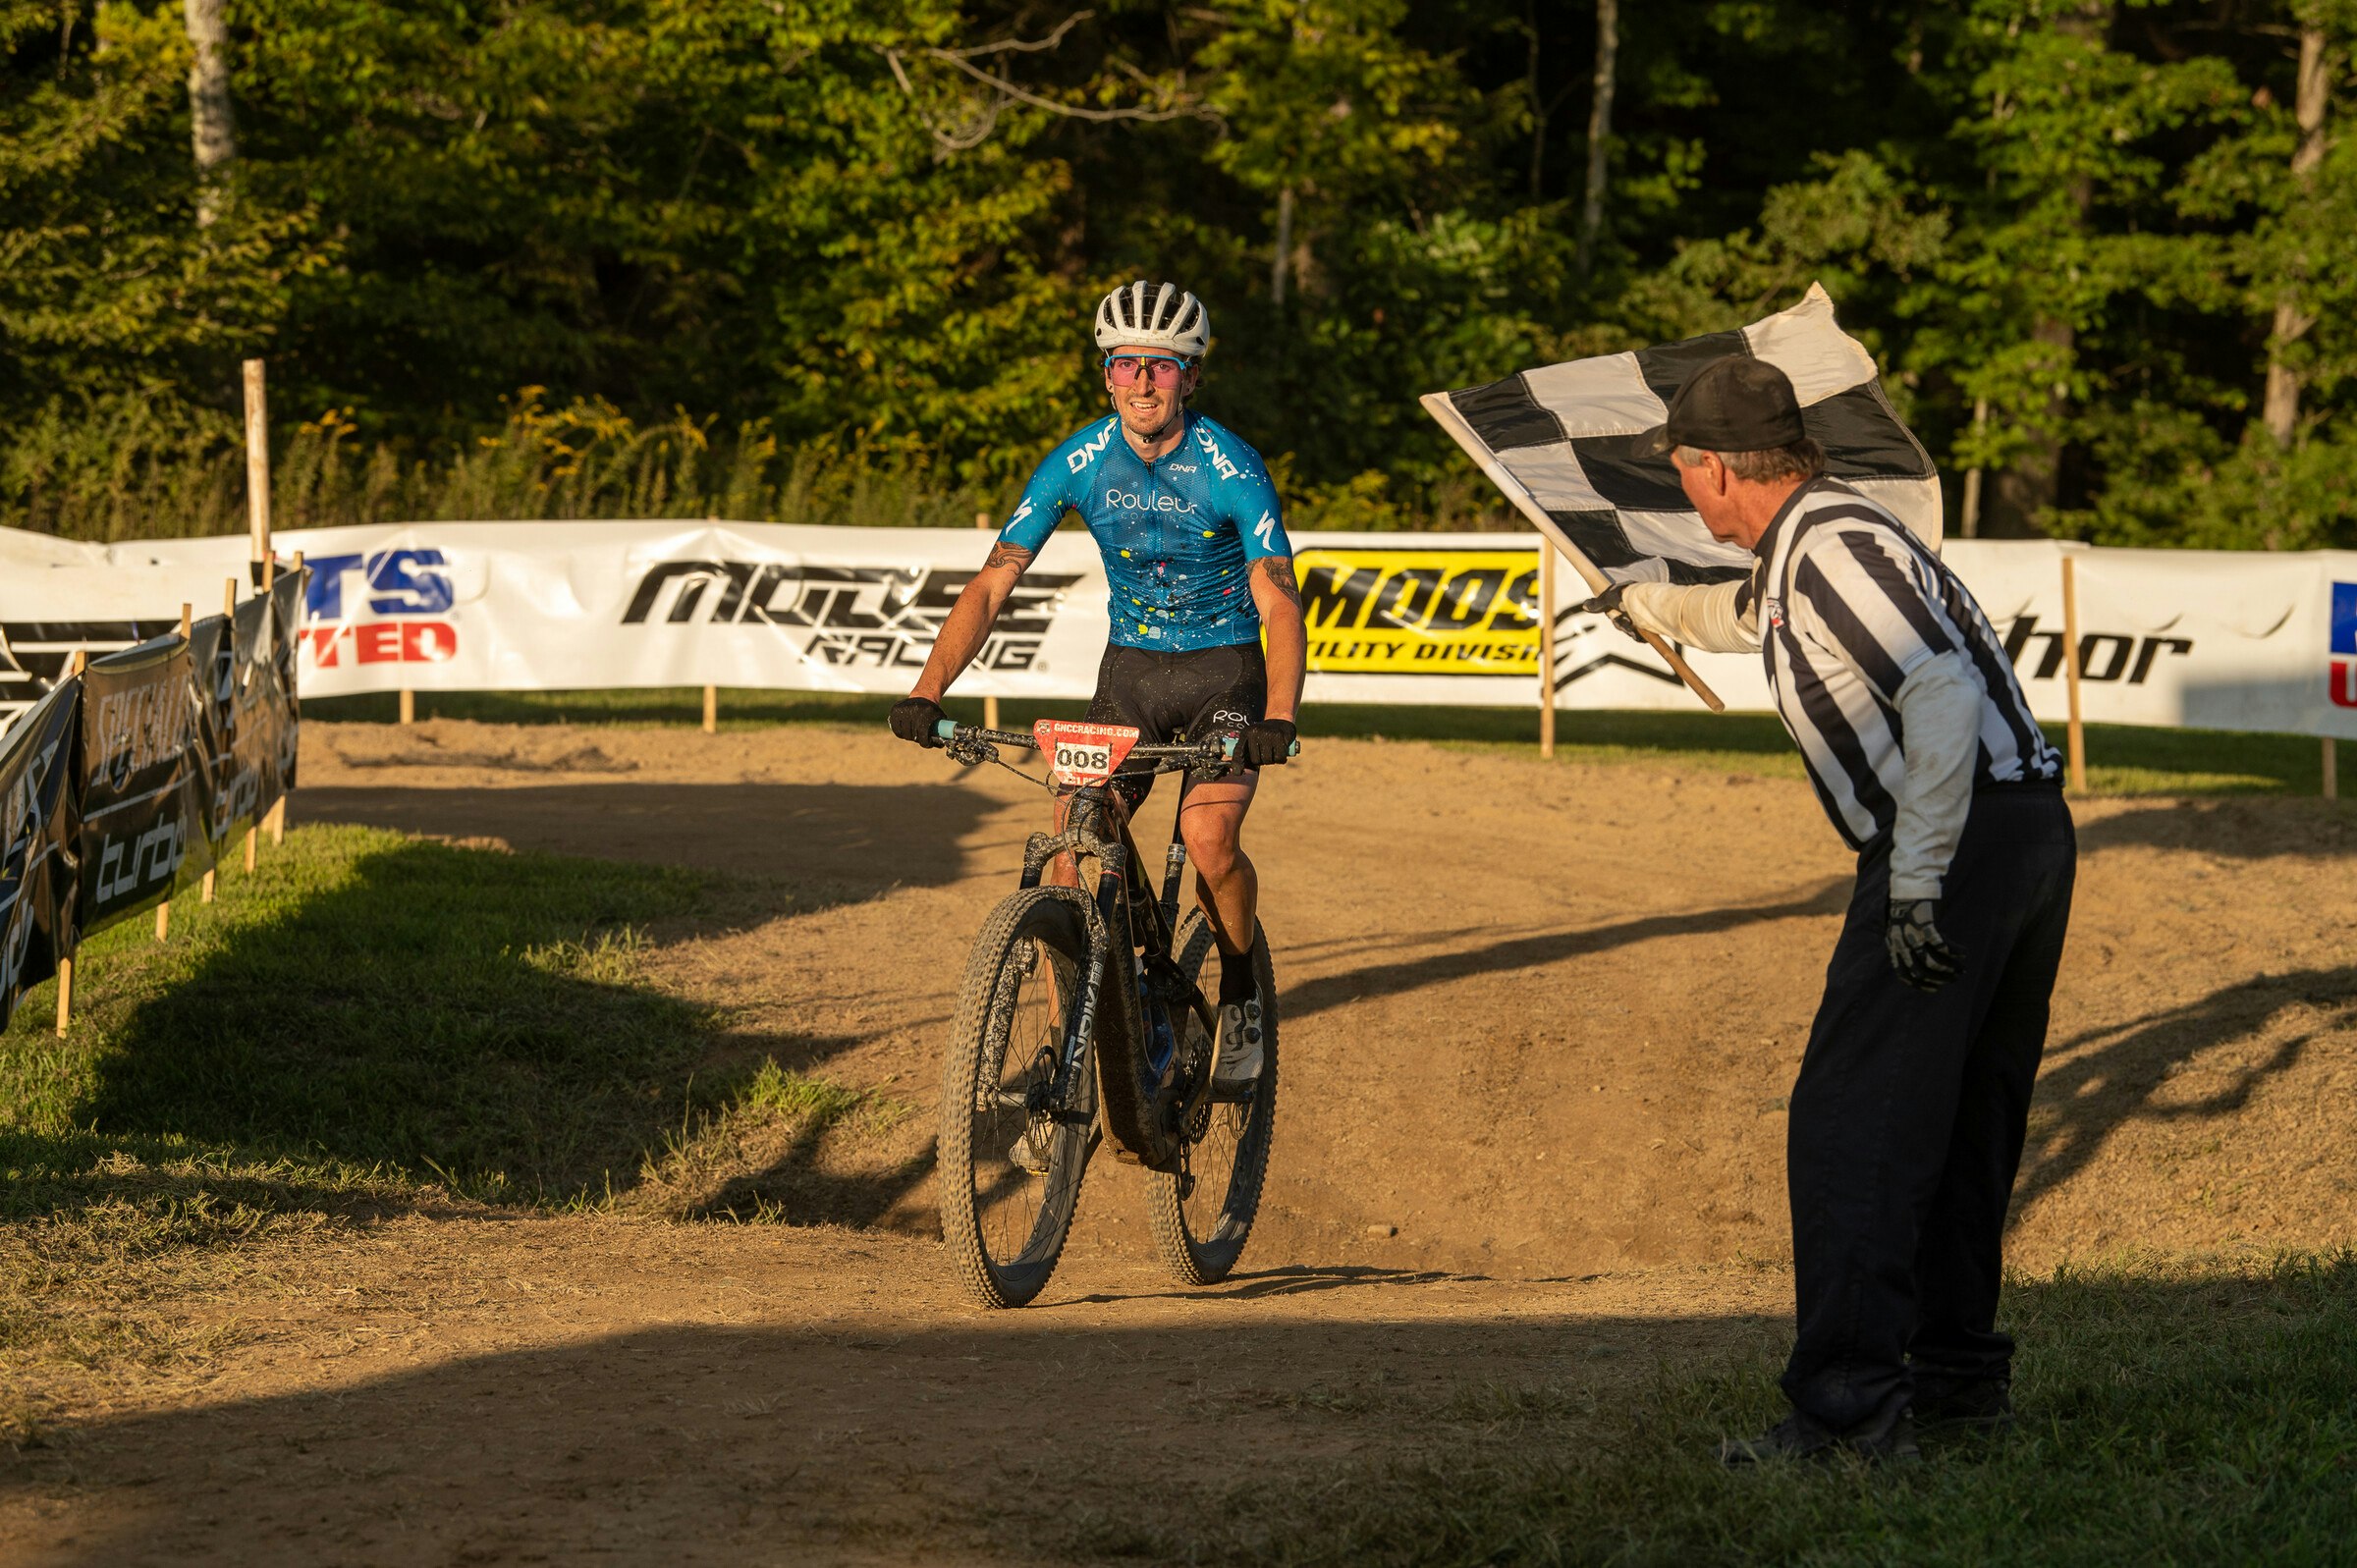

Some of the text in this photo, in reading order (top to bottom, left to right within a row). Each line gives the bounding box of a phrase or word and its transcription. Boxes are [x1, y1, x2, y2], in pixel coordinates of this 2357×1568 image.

[1192, 427, 1239, 481] DNA
[1169, 462, 1197, 473] DNA
[1106, 489, 1197, 514] Rouleur
[1121, 511, 1186, 522] COAHING
[1998, 615, 2193, 684] hor
[1054, 723, 1139, 738] GNCCRACING.COM
[1057, 748, 1108, 769] 008
[96, 813, 188, 903] turbo
